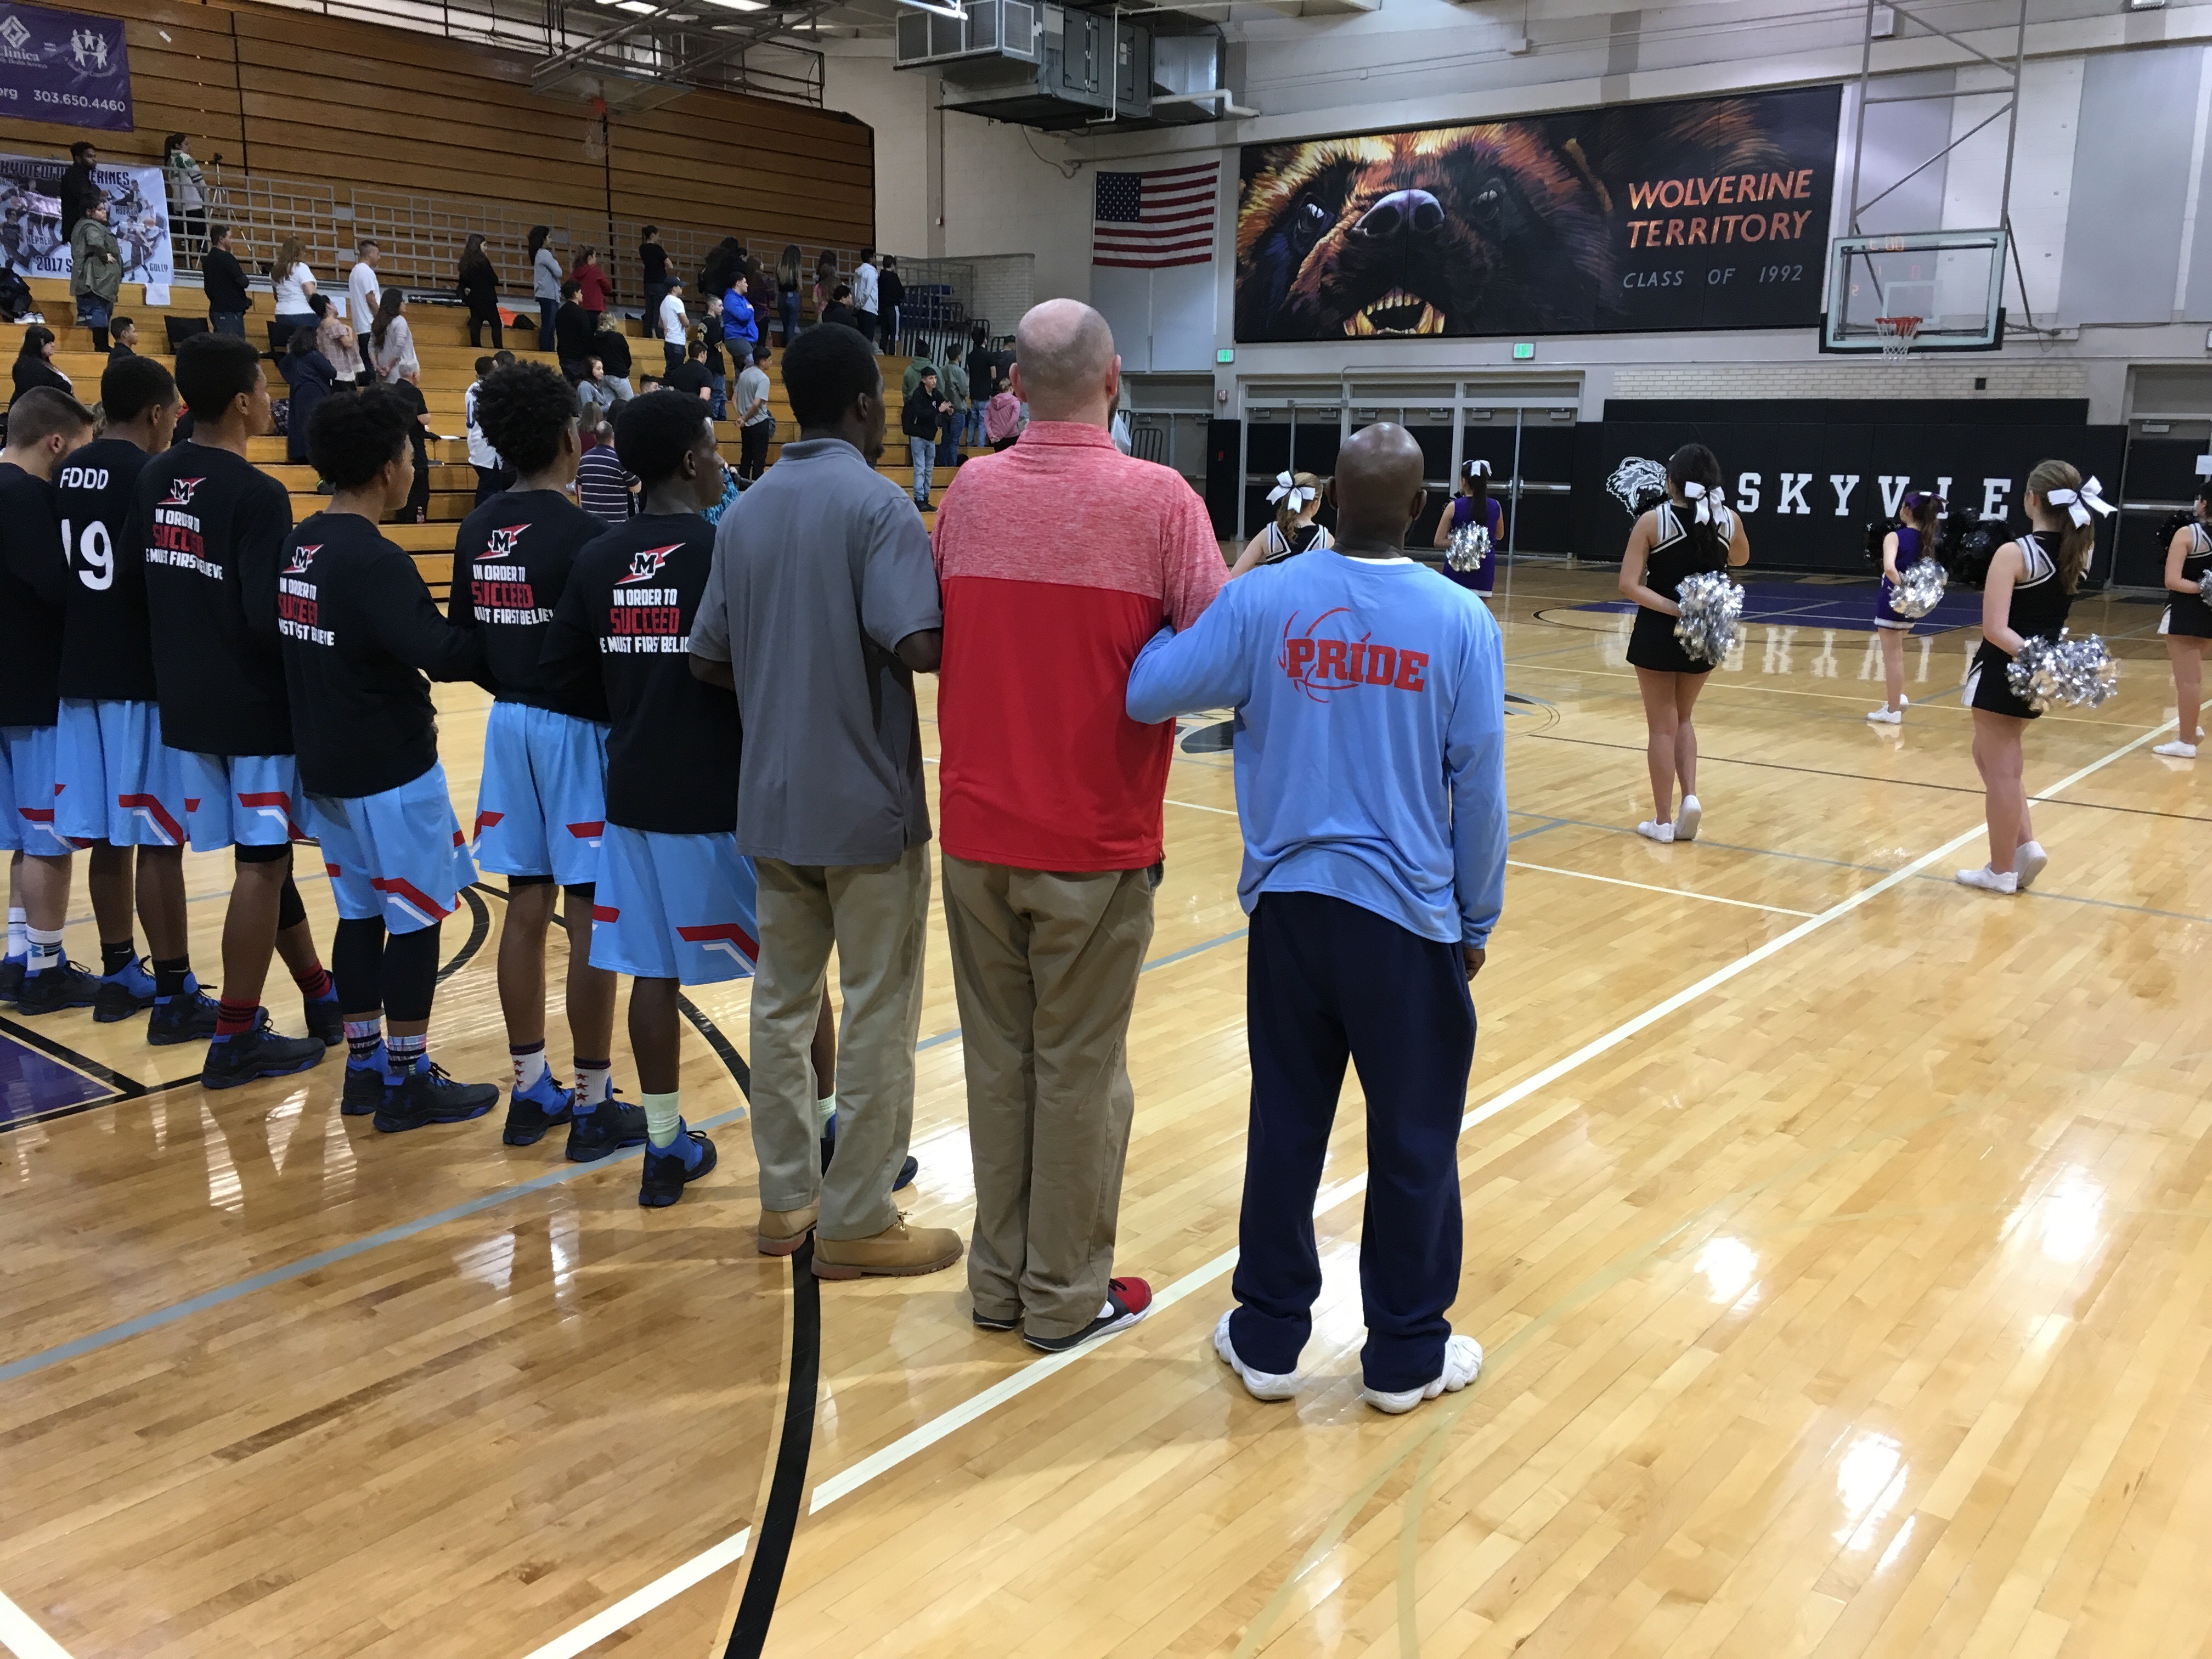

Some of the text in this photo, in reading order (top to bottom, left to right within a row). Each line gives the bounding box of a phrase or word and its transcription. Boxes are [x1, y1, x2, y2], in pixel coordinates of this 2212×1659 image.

[33, 89, 126, 112] 303.650.4460
[1628, 169, 1813, 210] WOLVERINE
[1627, 210, 1812, 249] TERRITORY
[36, 256, 63, 272] 2017
[1623, 264, 1803, 289] CLASS OF 1992
[473, 564, 483, 580] IN
[484, 565, 517, 582] ORDER
[471, 581, 535, 608] SUCCEED
[613, 588, 678, 606] IN ORDER TO
[493, 608, 519, 624] FIRST
[610, 607, 680, 634] SUCCEED
[607, 636, 631, 653] MUST
[1286, 637, 1430, 692] PRIDE
